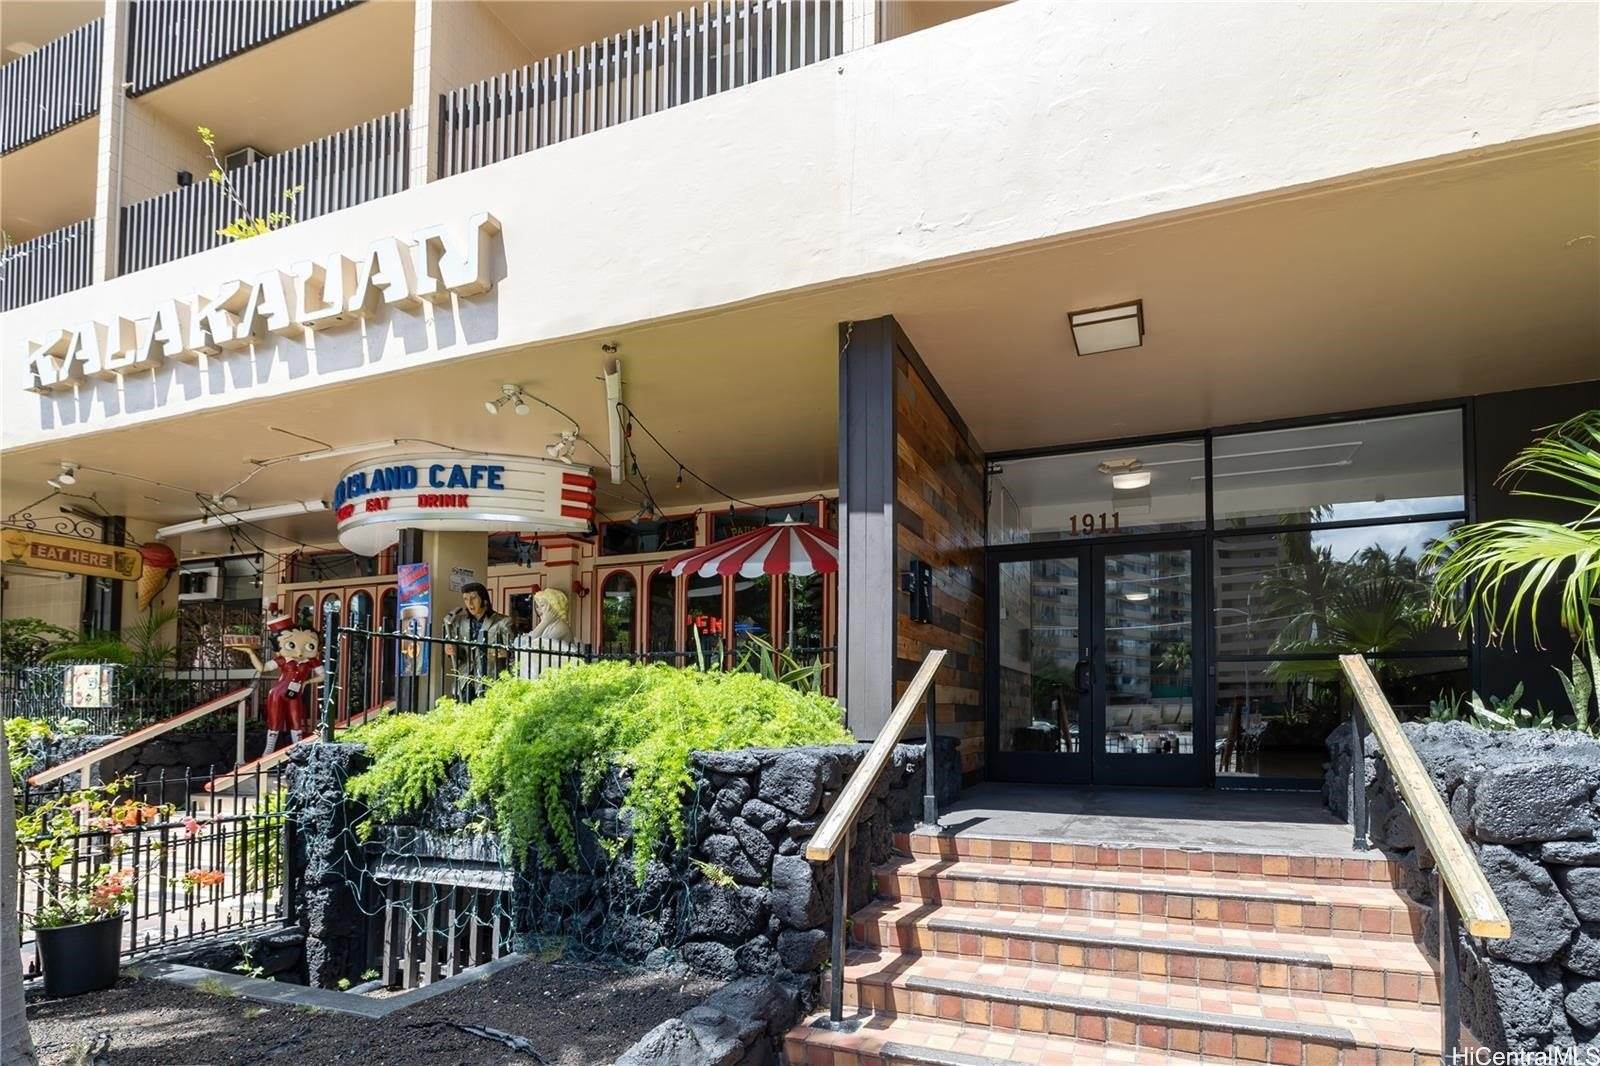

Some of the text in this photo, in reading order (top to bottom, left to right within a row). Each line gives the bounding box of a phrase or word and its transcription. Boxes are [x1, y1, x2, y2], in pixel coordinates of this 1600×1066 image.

[24, 212, 502, 391] KALAKAUAN
[347, 464, 418, 498] ISLAND
[429, 464, 505, 490] CAFE
[366, 494, 470, 512] EAT DRINK
[1069, 511, 1121, 536] 1911
[38, 546, 108, 566] EAT HERE
